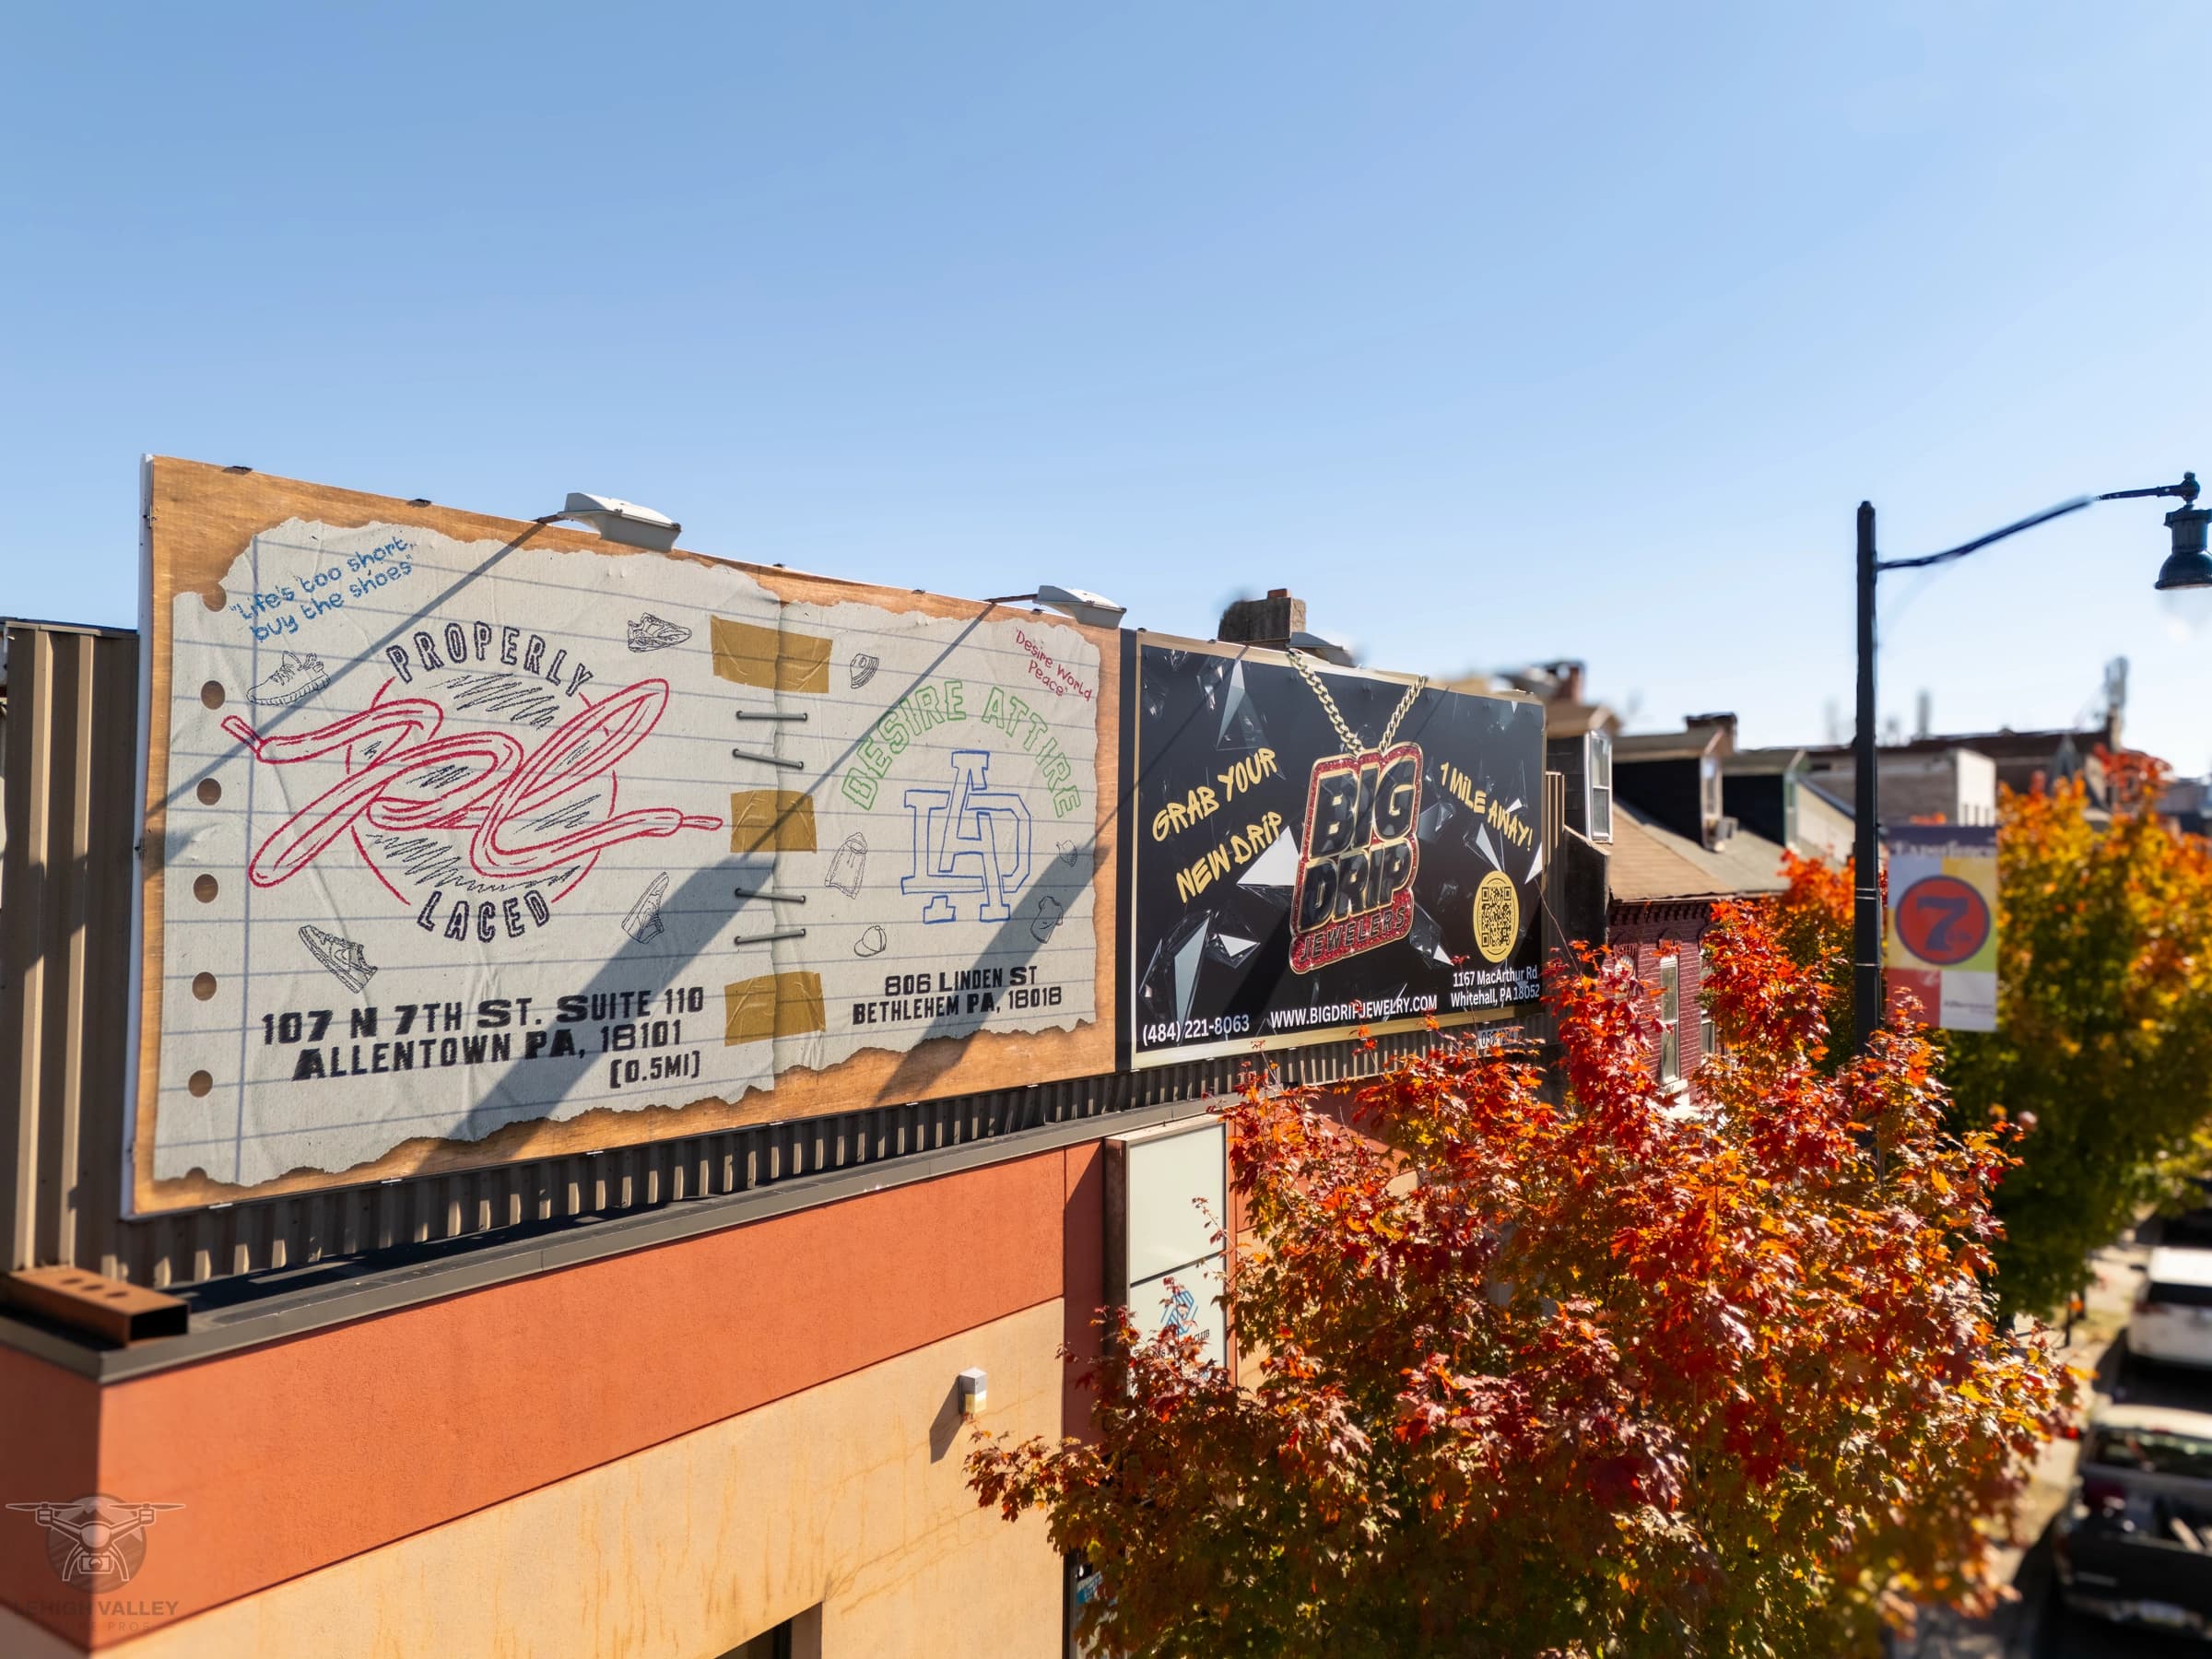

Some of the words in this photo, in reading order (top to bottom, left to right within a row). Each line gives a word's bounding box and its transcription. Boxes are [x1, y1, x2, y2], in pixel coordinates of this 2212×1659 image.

[295, 567, 342, 593] too
[251, 615, 299, 641] buy
[300, 593, 345, 619] the
[386, 621, 594, 697] PROPERLY
[1057, 664, 1092, 701] World
[841, 678, 966, 811] DESIRE
[982, 686, 1081, 818] ATTIRE
[1152, 786, 1219, 841] GRAB
[1218, 747, 1277, 802] YOUR
[1308, 756, 1417, 861] BIG
[1441, 761, 1449, 786] 1
[1488, 799, 1533, 852] AWAY!
[1176, 843, 1230, 903] NEW
[1298, 838, 1414, 934] DRIP
[417, 890, 550, 943] LACED
[1300, 906, 1406, 963] JEWELERS
[885, 973, 931, 996] 806
[939, 969, 1003, 992] LINDEN
[1010, 966, 1037, 985] ST
[1451, 990, 1498, 1007] Whitehall,
[1500, 987, 1512, 1002] PA
[1513, 984, 1540, 1000] 18052
[1453, 971, 1475, 987] 1167
[1477, 967, 1524, 985] MacArthur
[1526, 965, 1537, 979] Rd
[262, 1010, 333, 1045] 107
[350, 1006, 378, 1039] N
[394, 1002, 462, 1035] 7TH
[556, 991, 652, 1023] SUITE
[665, 987, 703, 1014] 110
[853, 995, 959, 1025] BETHLEHEM
[967, 993, 1000, 1014] PA,
[1008, 986, 1062, 1009] 18018
[1143, 1021, 1181, 1046] (484)
[1184, 1014, 1250, 1039] 221-8063
[291, 1033, 511, 1082] ALLENTOWN
[524, 1029, 585, 1059] PA,
[600, 1019, 681, 1053] 18101
